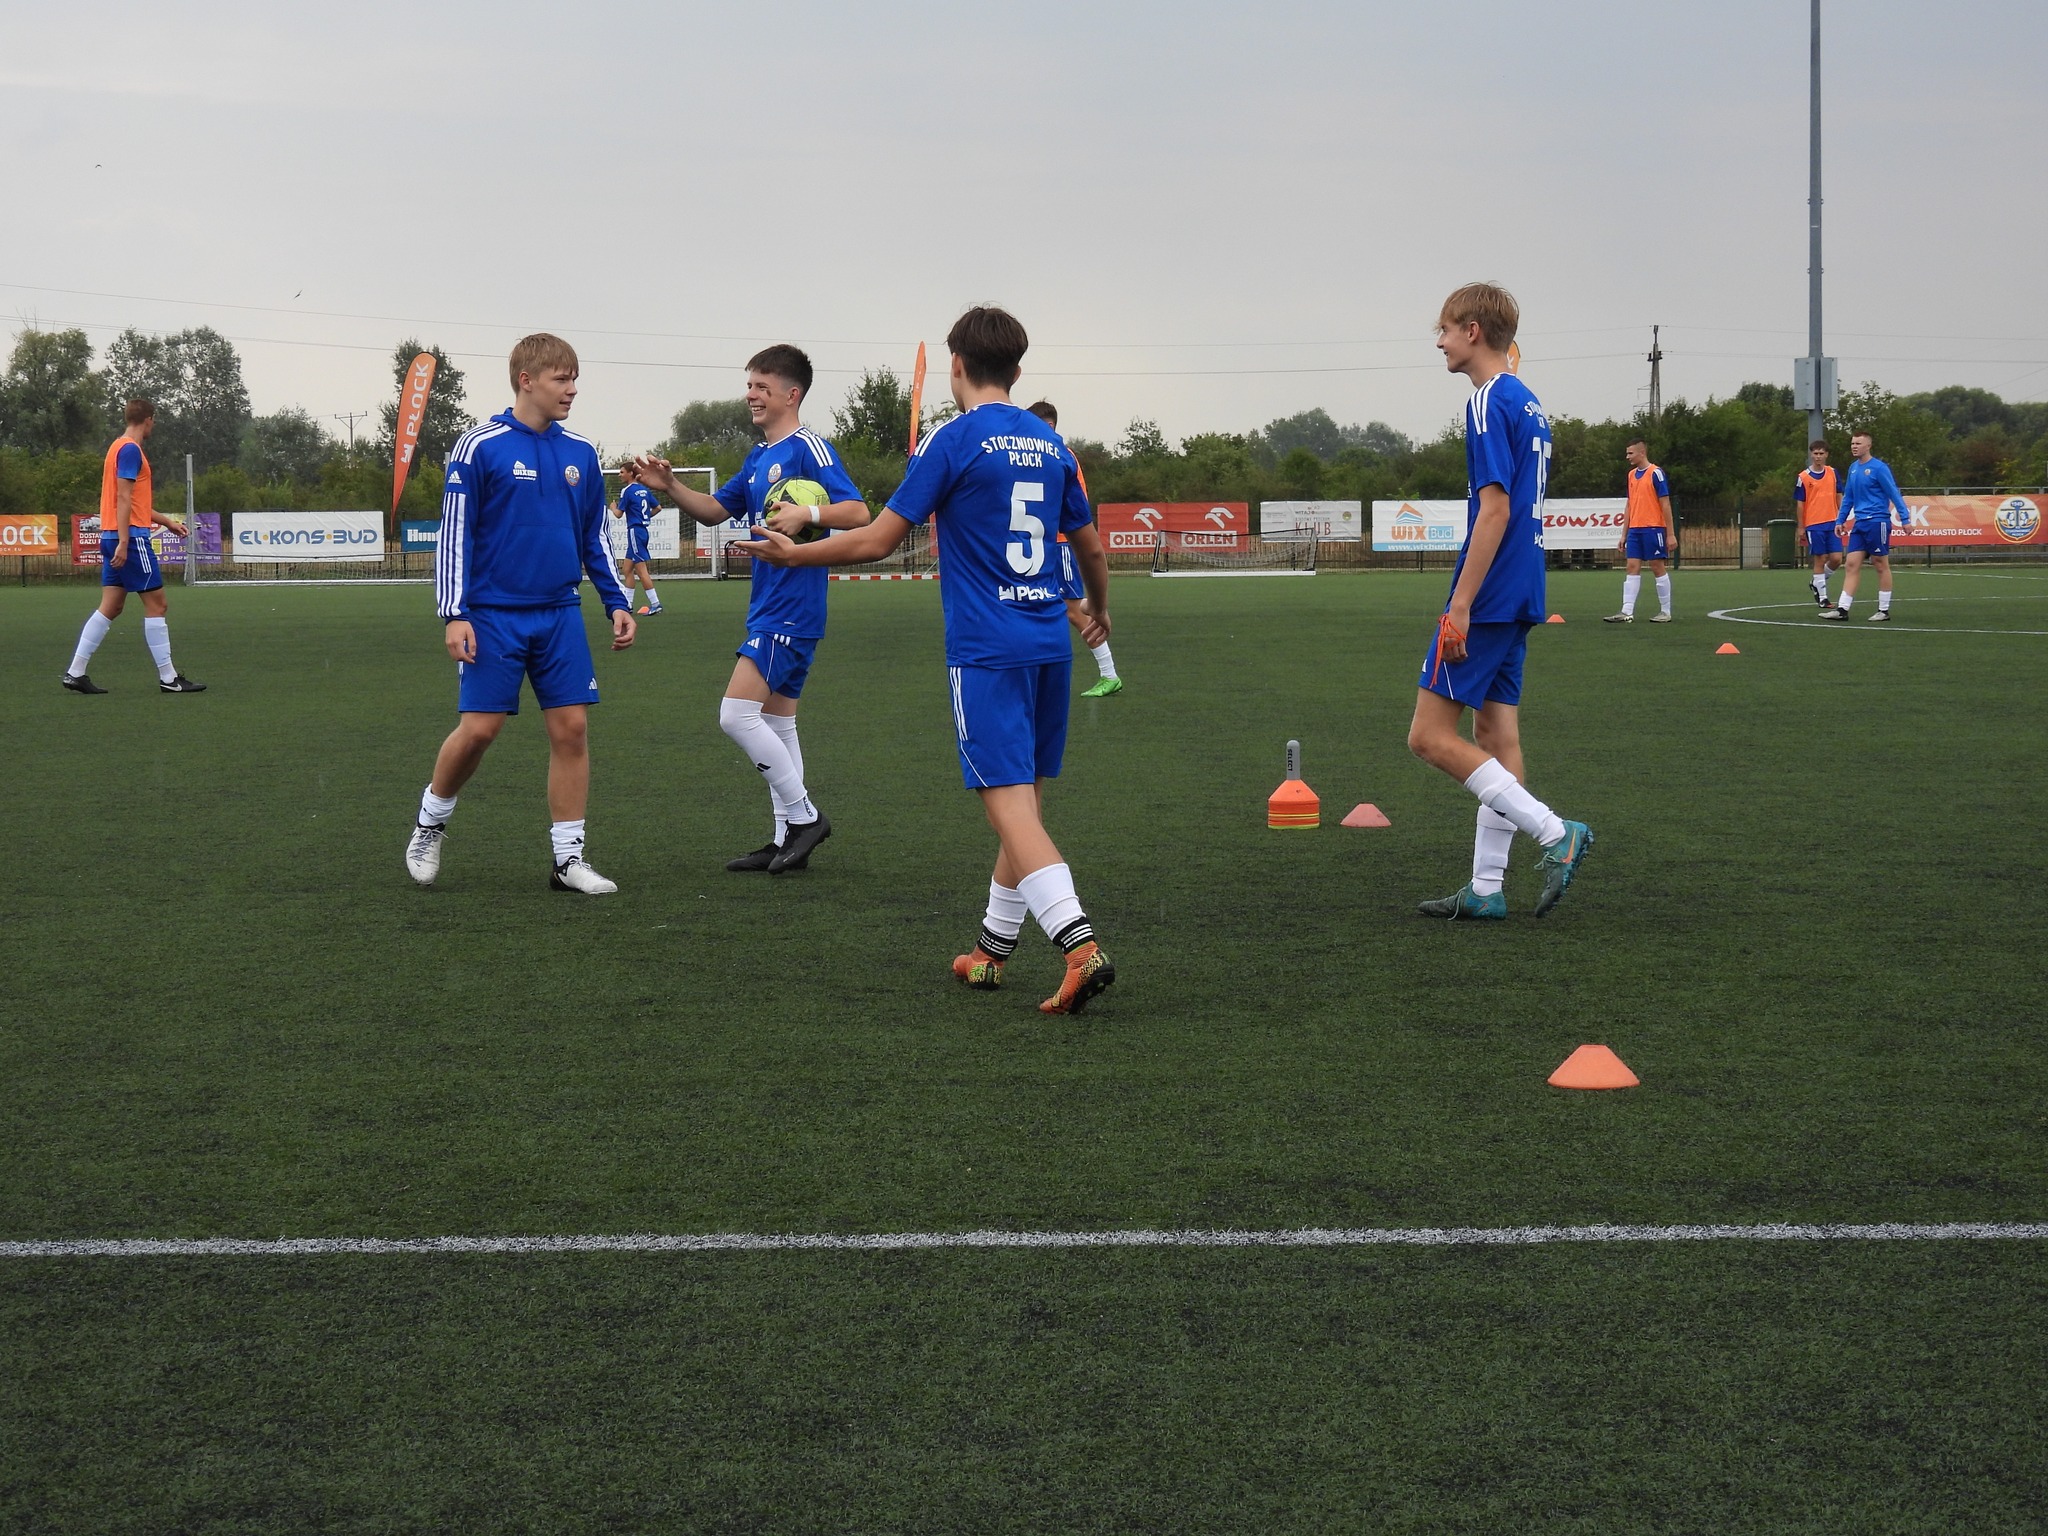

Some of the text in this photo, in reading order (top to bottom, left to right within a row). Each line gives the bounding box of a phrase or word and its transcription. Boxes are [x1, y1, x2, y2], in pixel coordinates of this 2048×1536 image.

[406, 363, 429, 437] PŁOCK
[981, 435, 1060, 460] STOCZNIOWIEC
[1008, 451, 1043, 468] PŁOCK
[641, 499, 649, 520] 2
[1543, 512, 1625, 528] zowsze
[0, 525, 48, 546] OCK
[1006, 481, 1045, 577] 5
[1430, 527, 1453, 539] Bud
[1929, 528, 1957, 536] MIASTO
[1958, 528, 1983, 536] PŁOCK
[1184, 532, 1234, 545] ORLEN
[1387, 543, 1458, 552] www.wixbud.pl
